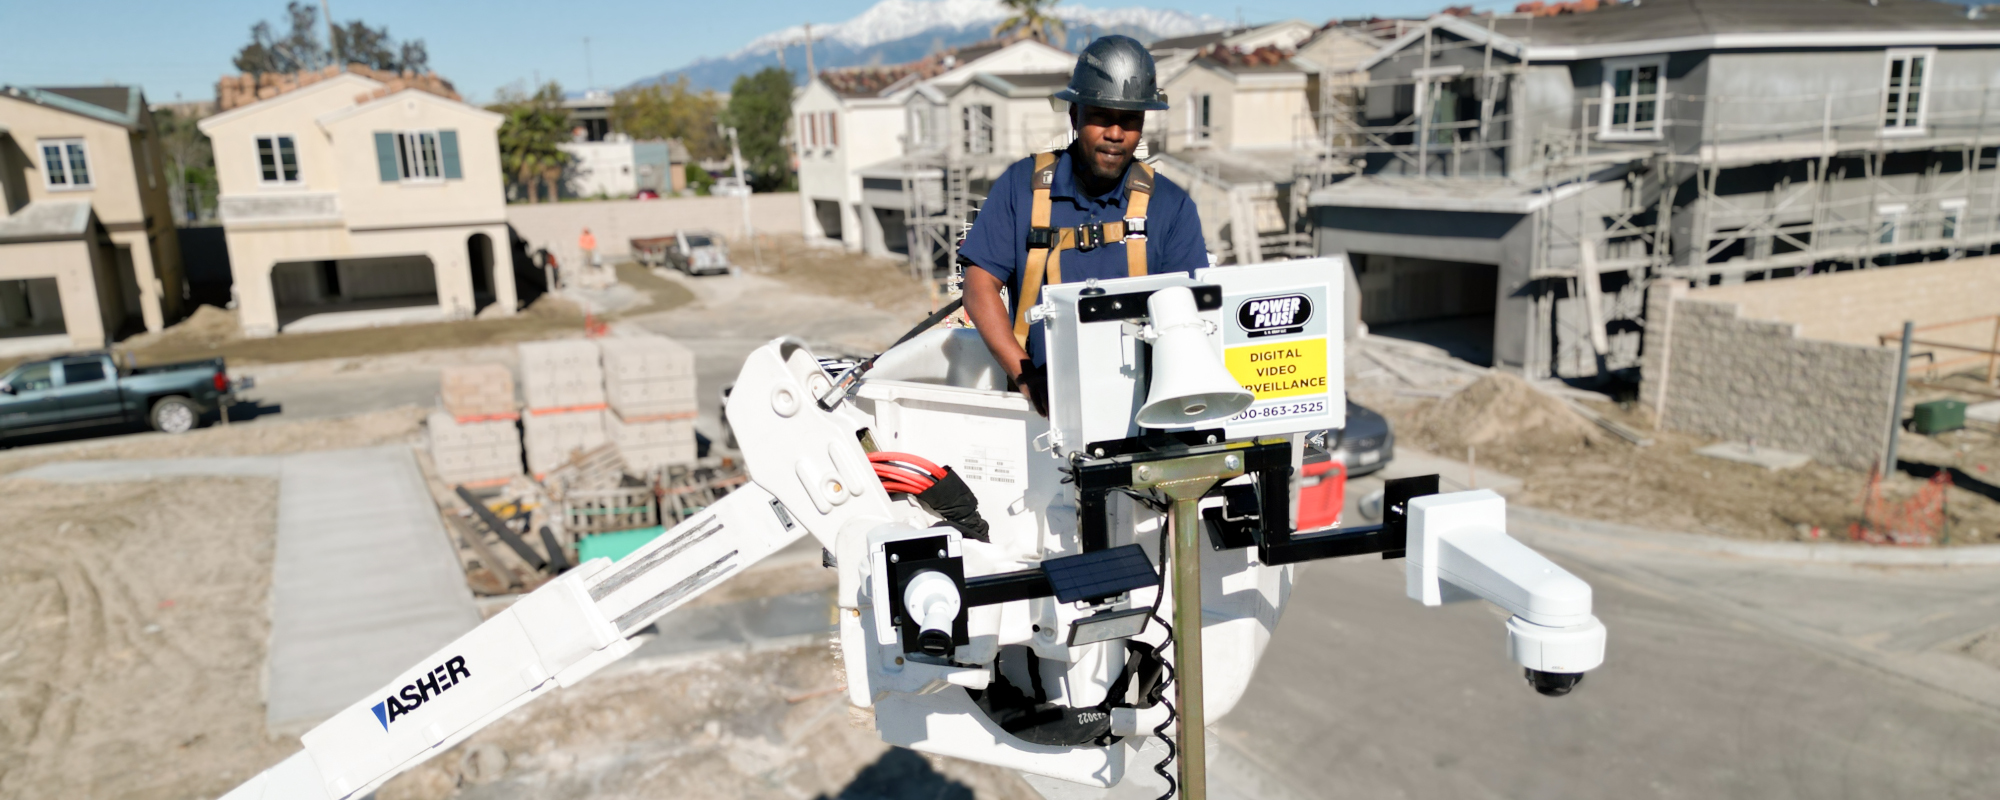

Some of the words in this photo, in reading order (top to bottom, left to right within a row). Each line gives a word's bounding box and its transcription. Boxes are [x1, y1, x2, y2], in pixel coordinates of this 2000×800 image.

[1249, 297, 1301, 316] POWER
[1254, 310, 1293, 328] PLUS!
[1250, 348, 1302, 363] DIGITAL
[1256, 364, 1297, 377] VIDEO
[1241, 376, 1326, 393] RVEILLANCE
[386, 655, 471, 724] ASHER
